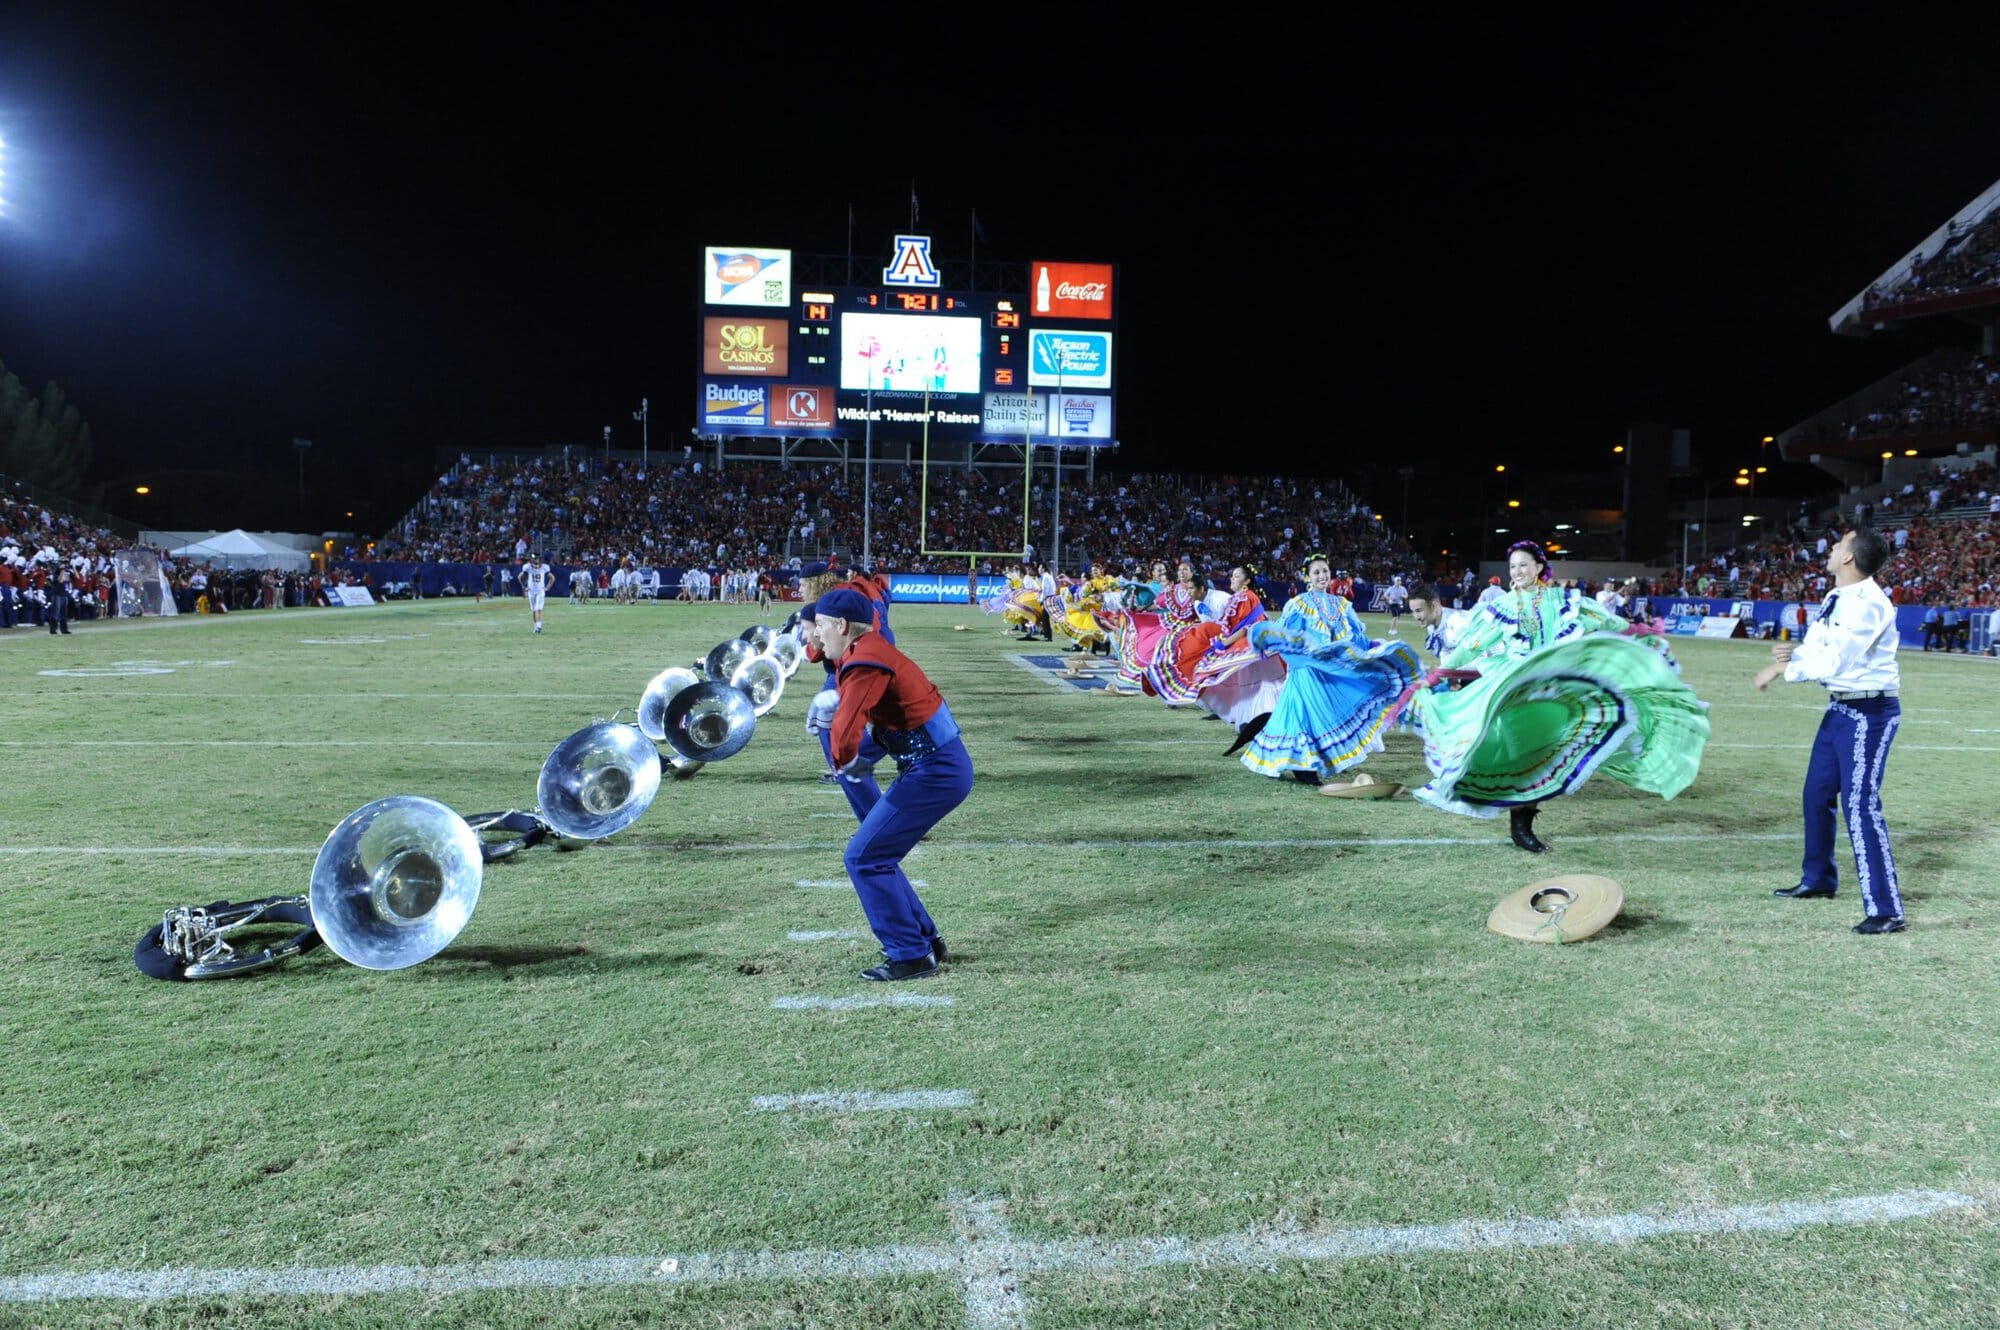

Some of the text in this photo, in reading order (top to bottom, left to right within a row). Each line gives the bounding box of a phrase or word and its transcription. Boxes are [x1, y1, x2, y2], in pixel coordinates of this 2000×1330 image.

[883, 235, 940, 287] A
[870, 294, 878, 306] 3
[897, 292, 938, 310] 7:21
[946, 297, 954, 309] 3
[997, 313, 1019, 328] 24
[720, 324, 774, 351] SOL
[1052, 337, 1091, 350] Tucson
[719, 351, 774, 363] CASINOS
[1055, 349, 1101, 362] Electric
[1059, 360, 1100, 372] Power
[706, 383, 765, 406] Budget
[837, 408, 881, 421] Wildcat
[937, 411, 980, 425] Raisers
[984, 408, 1045, 424] Daily Sar
